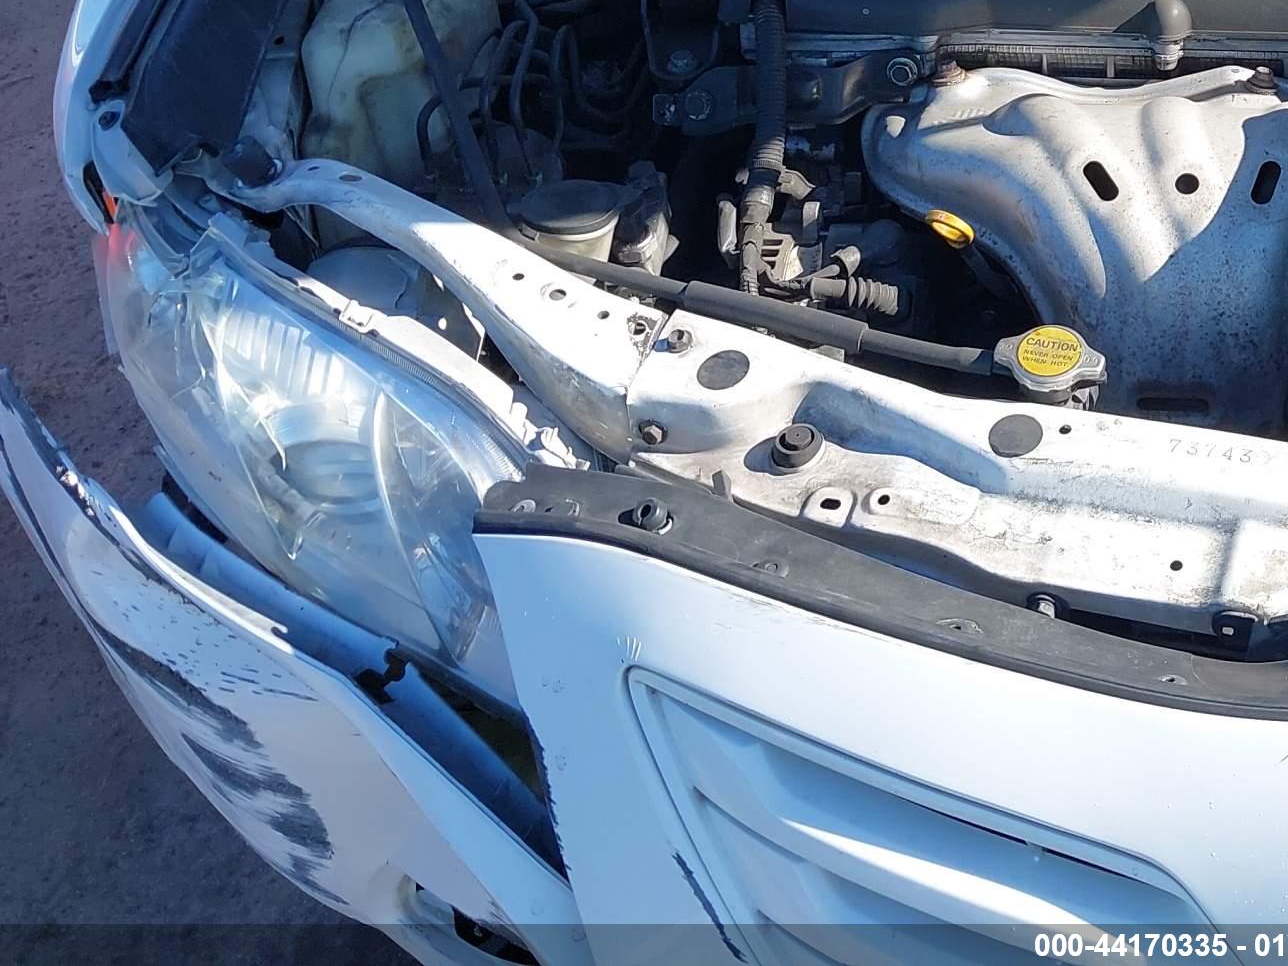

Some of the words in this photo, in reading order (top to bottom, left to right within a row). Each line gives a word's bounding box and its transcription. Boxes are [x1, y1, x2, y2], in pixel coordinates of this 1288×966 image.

[1026, 337, 1078, 352] CAUTION
[1022, 355, 1047, 364] WHEN
[1023, 349, 1049, 358] NEVER
[1051, 353, 1074, 361] OPEN
